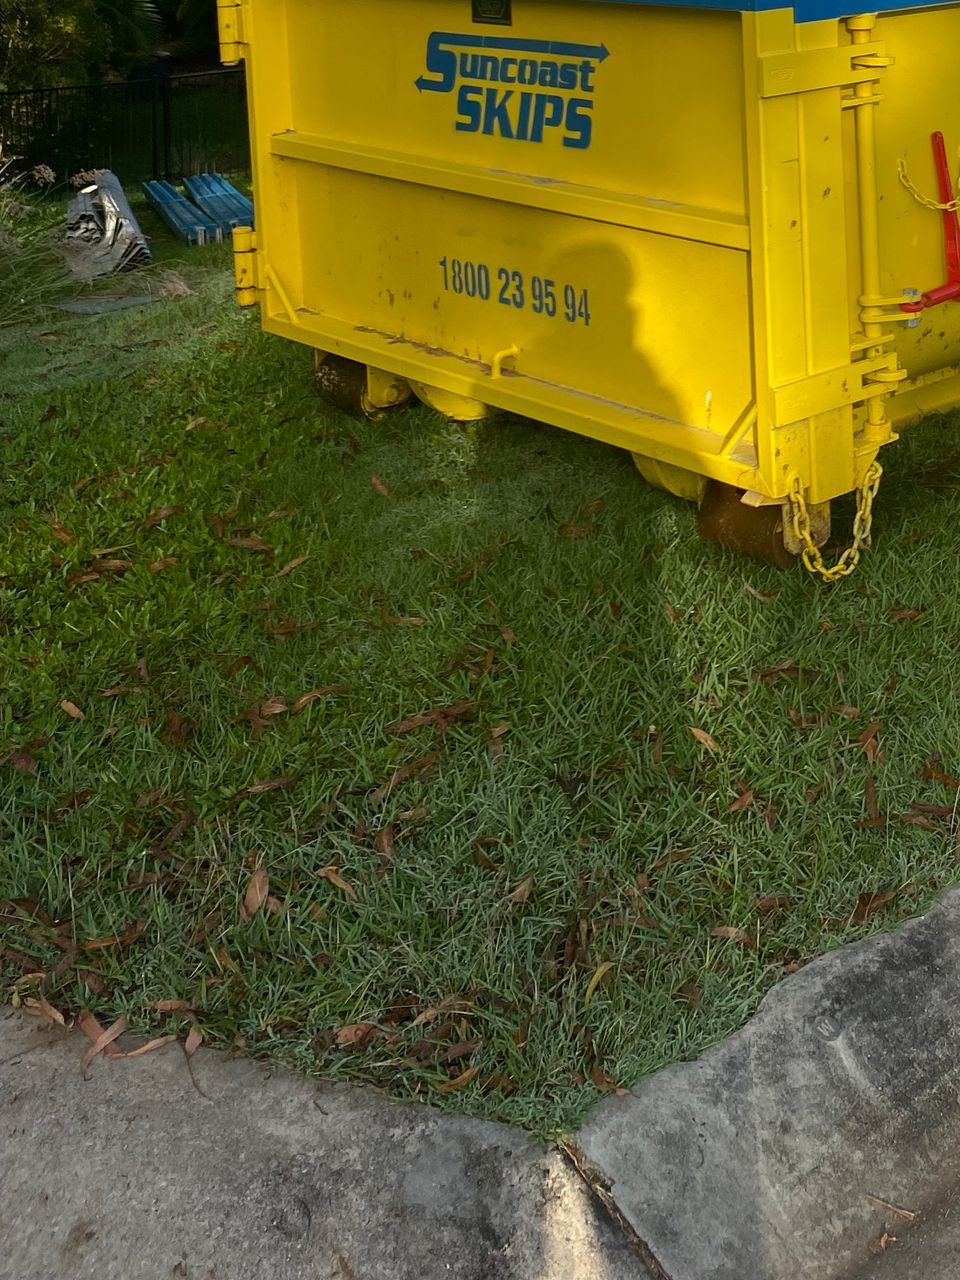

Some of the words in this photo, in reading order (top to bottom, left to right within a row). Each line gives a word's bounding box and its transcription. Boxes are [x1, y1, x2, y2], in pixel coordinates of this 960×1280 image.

[416, 31, 605, 93] Suncoast
[455, 84, 594, 150] SKIPS
[439, 256, 490, 300] 1800
[497, 267, 525, 309] 23
[531, 276, 557, 317] 95
[564, 284, 591, 326] 94
